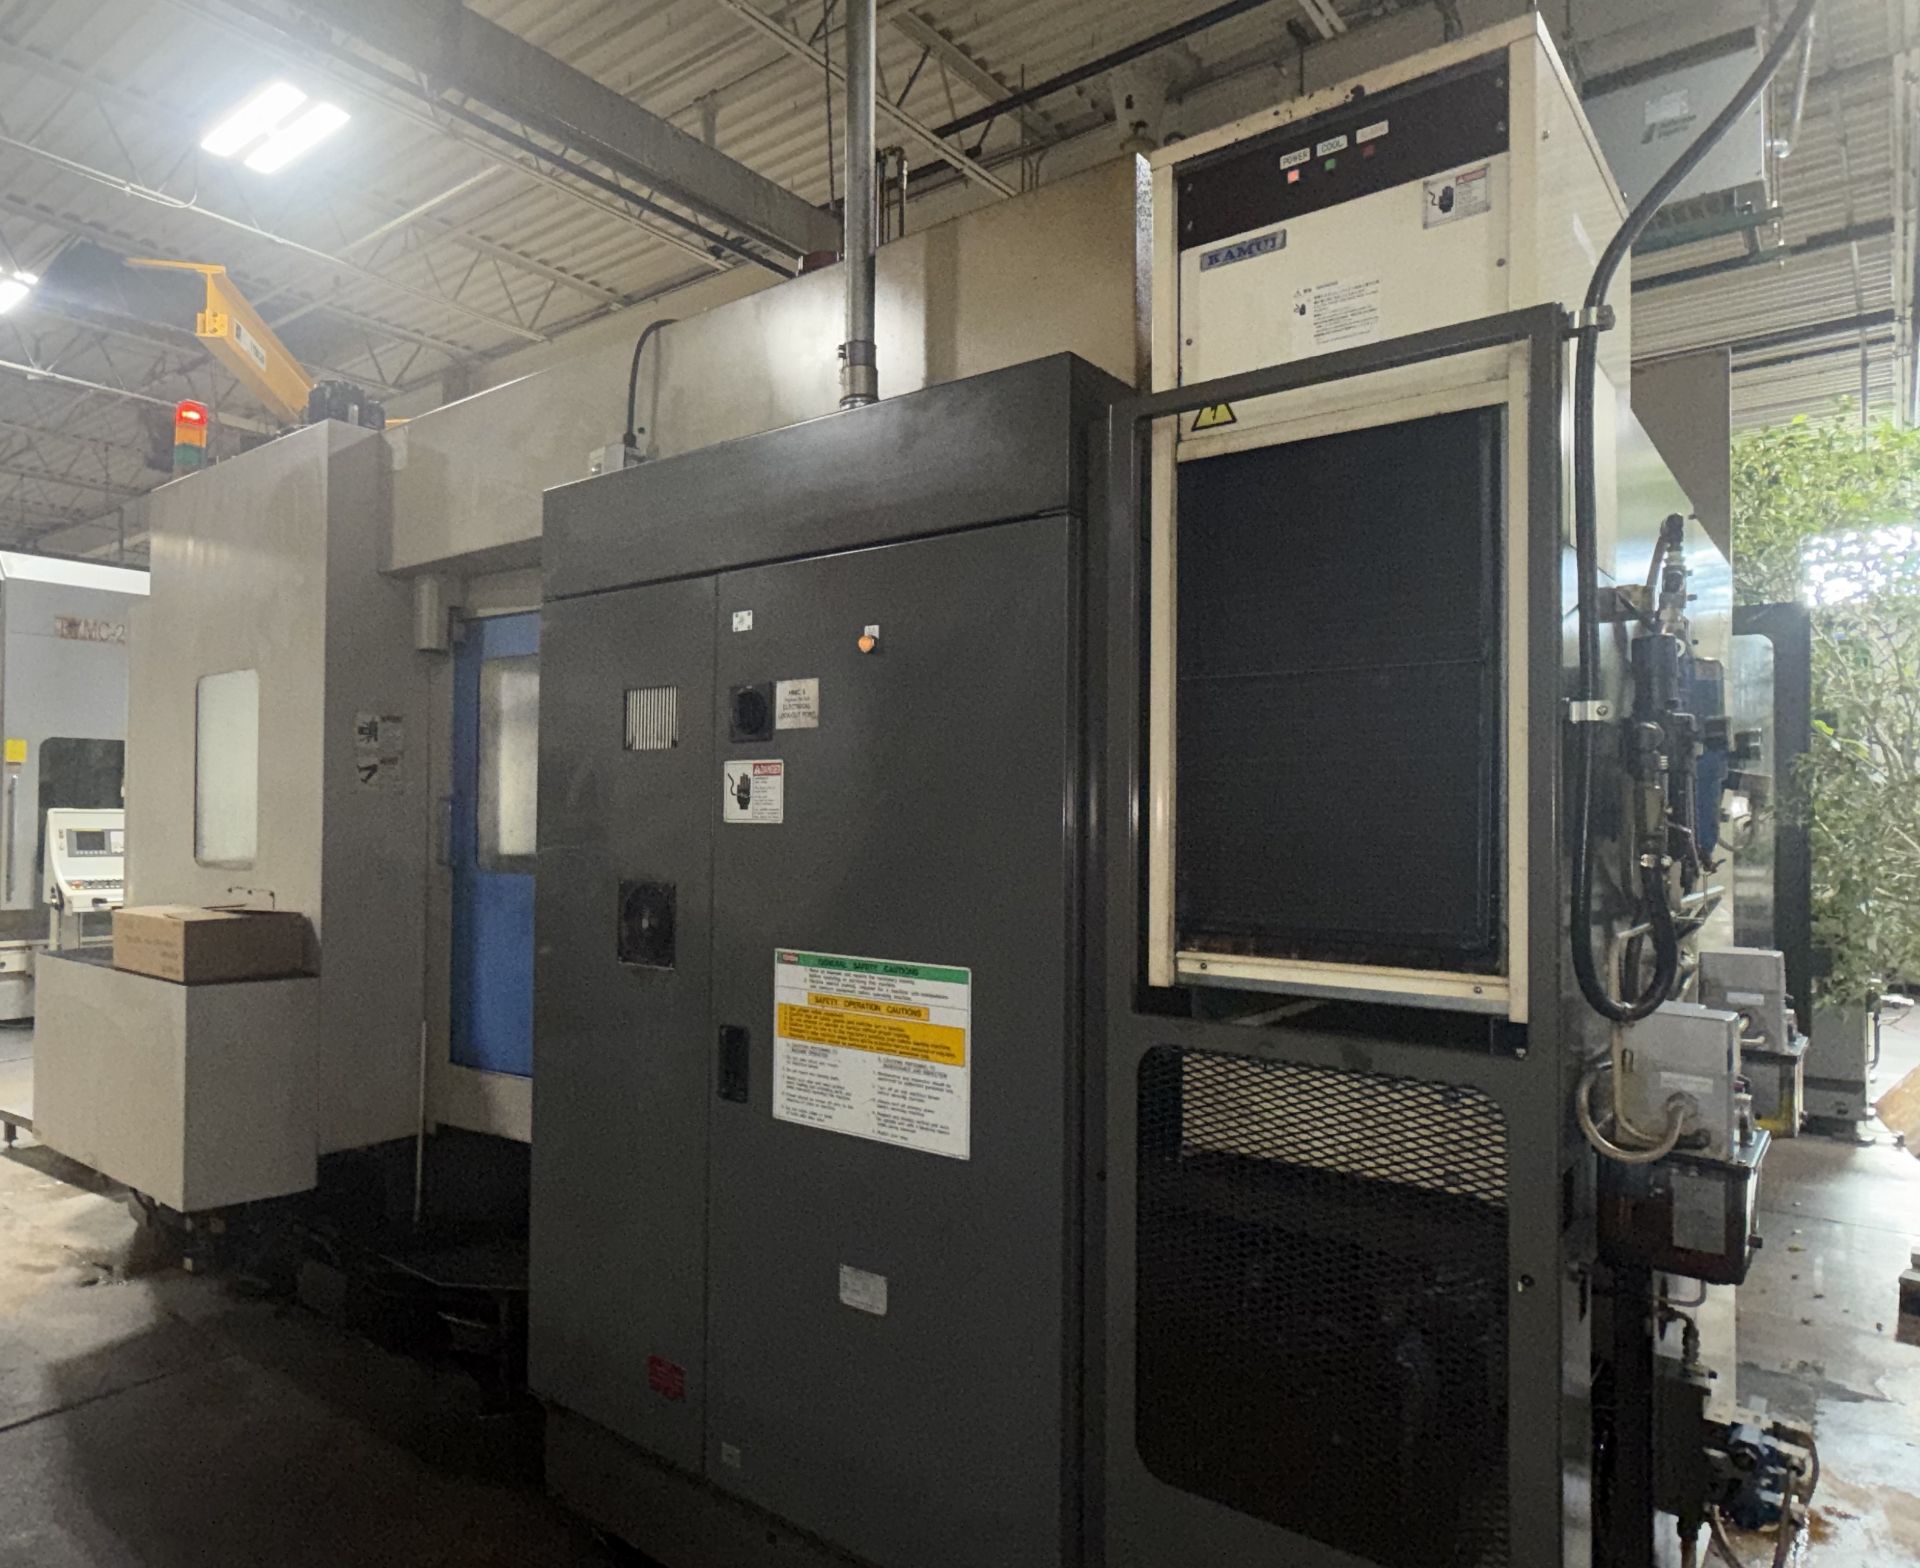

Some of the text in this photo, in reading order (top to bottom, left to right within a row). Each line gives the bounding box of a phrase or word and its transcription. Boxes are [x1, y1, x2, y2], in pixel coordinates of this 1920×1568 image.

[1321, 140, 1344, 153] COOL
[1282, 150, 1309, 167] POWER
[883, 965, 920, 976] CAUTIONS
[814, 995, 922, 1017] SAFETY OPERATION CAUTIONS
